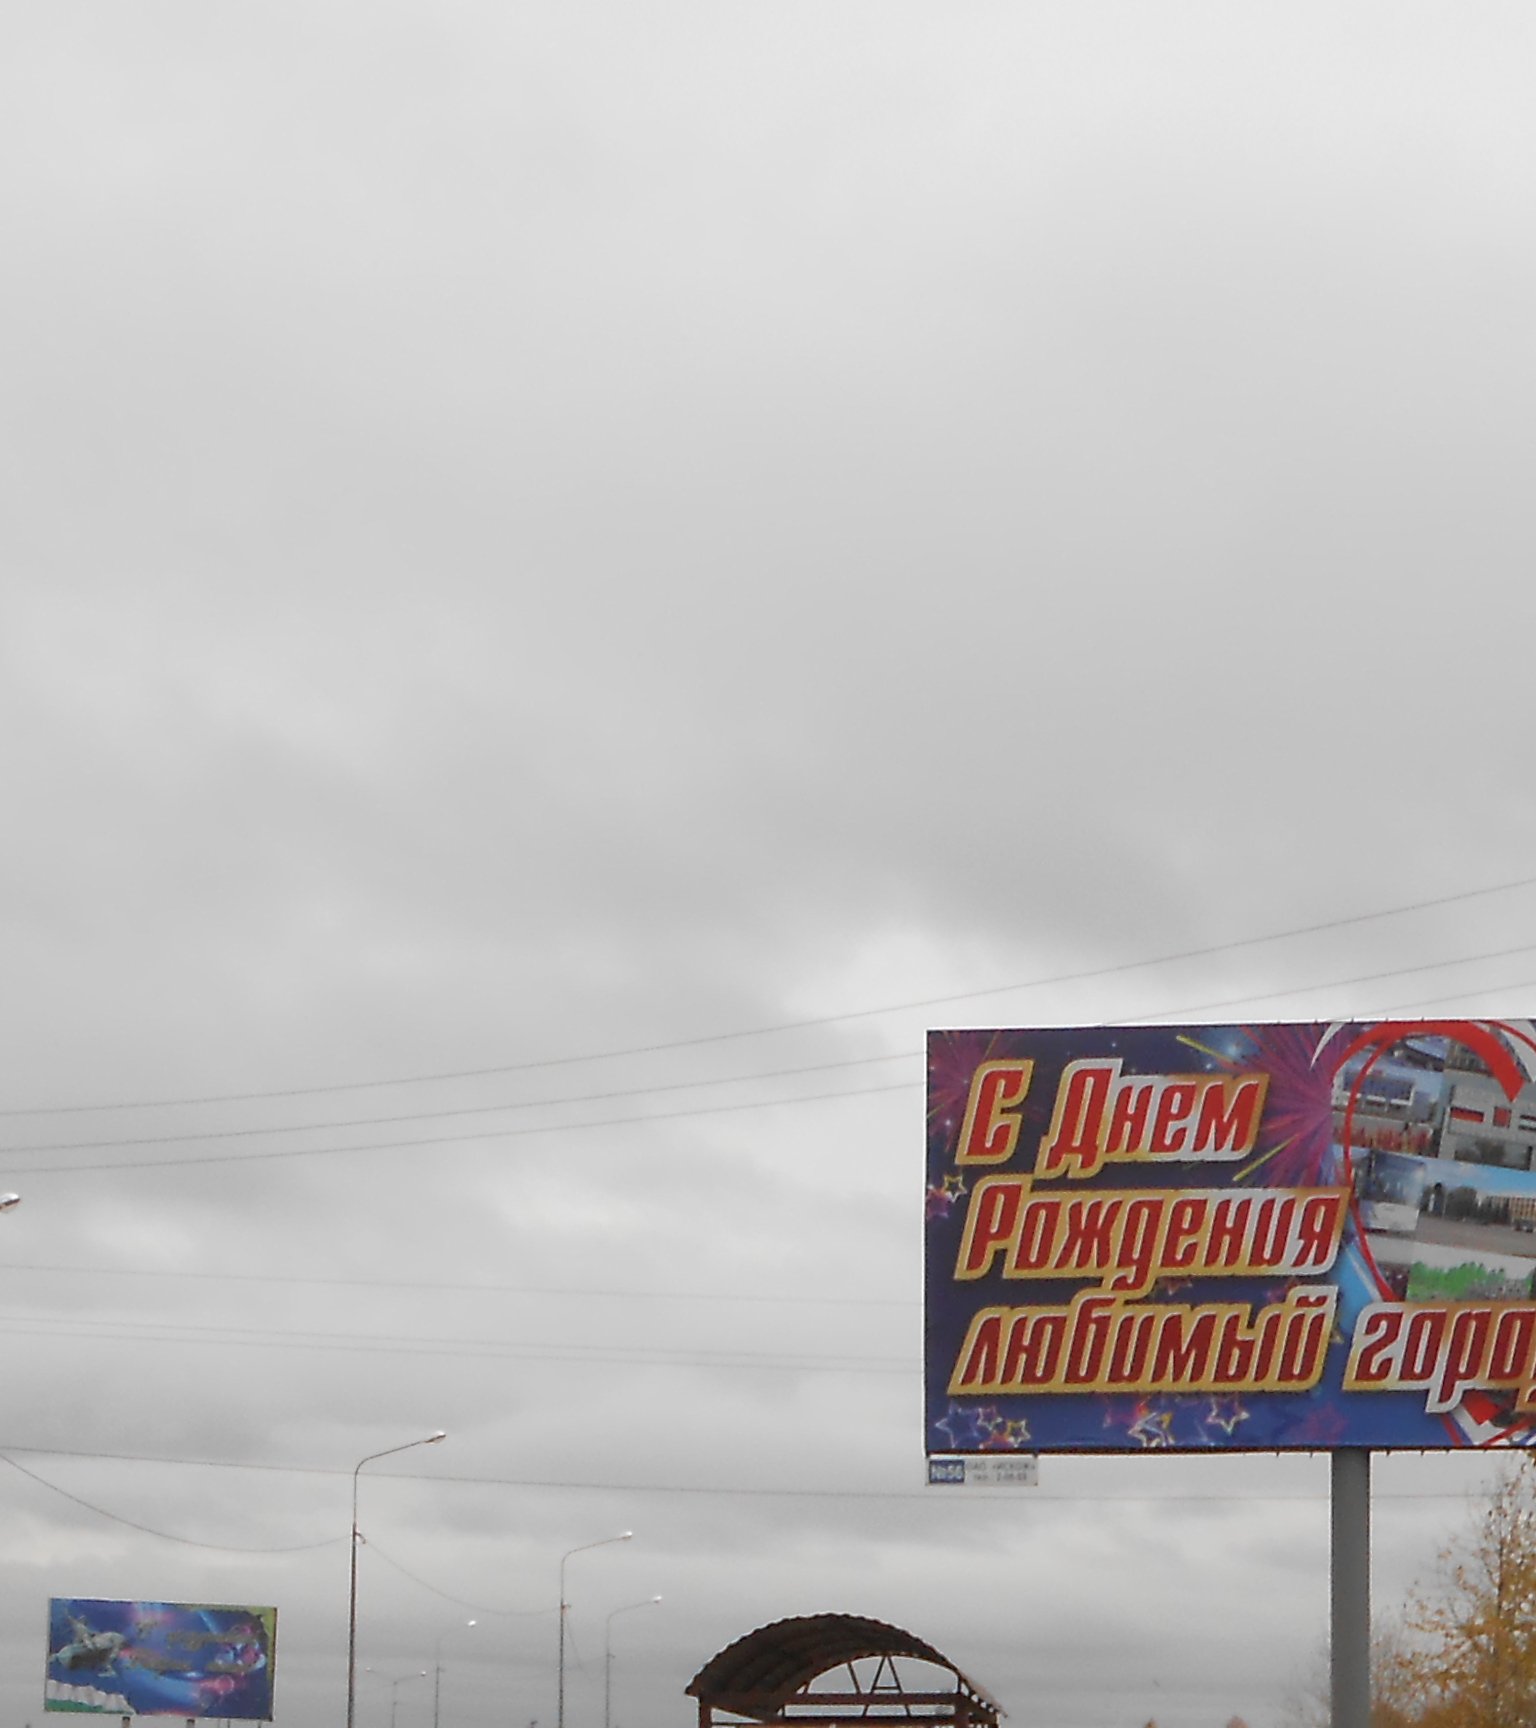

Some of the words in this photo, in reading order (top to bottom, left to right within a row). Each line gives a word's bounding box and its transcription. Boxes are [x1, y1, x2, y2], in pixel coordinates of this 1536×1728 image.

[961, 1063, 1030, 1160] С
[1039, 1062, 1264, 1175] Днем
[961, 1179, 1344, 1295] Рождения
[956, 1291, 1332, 1390] любимый
